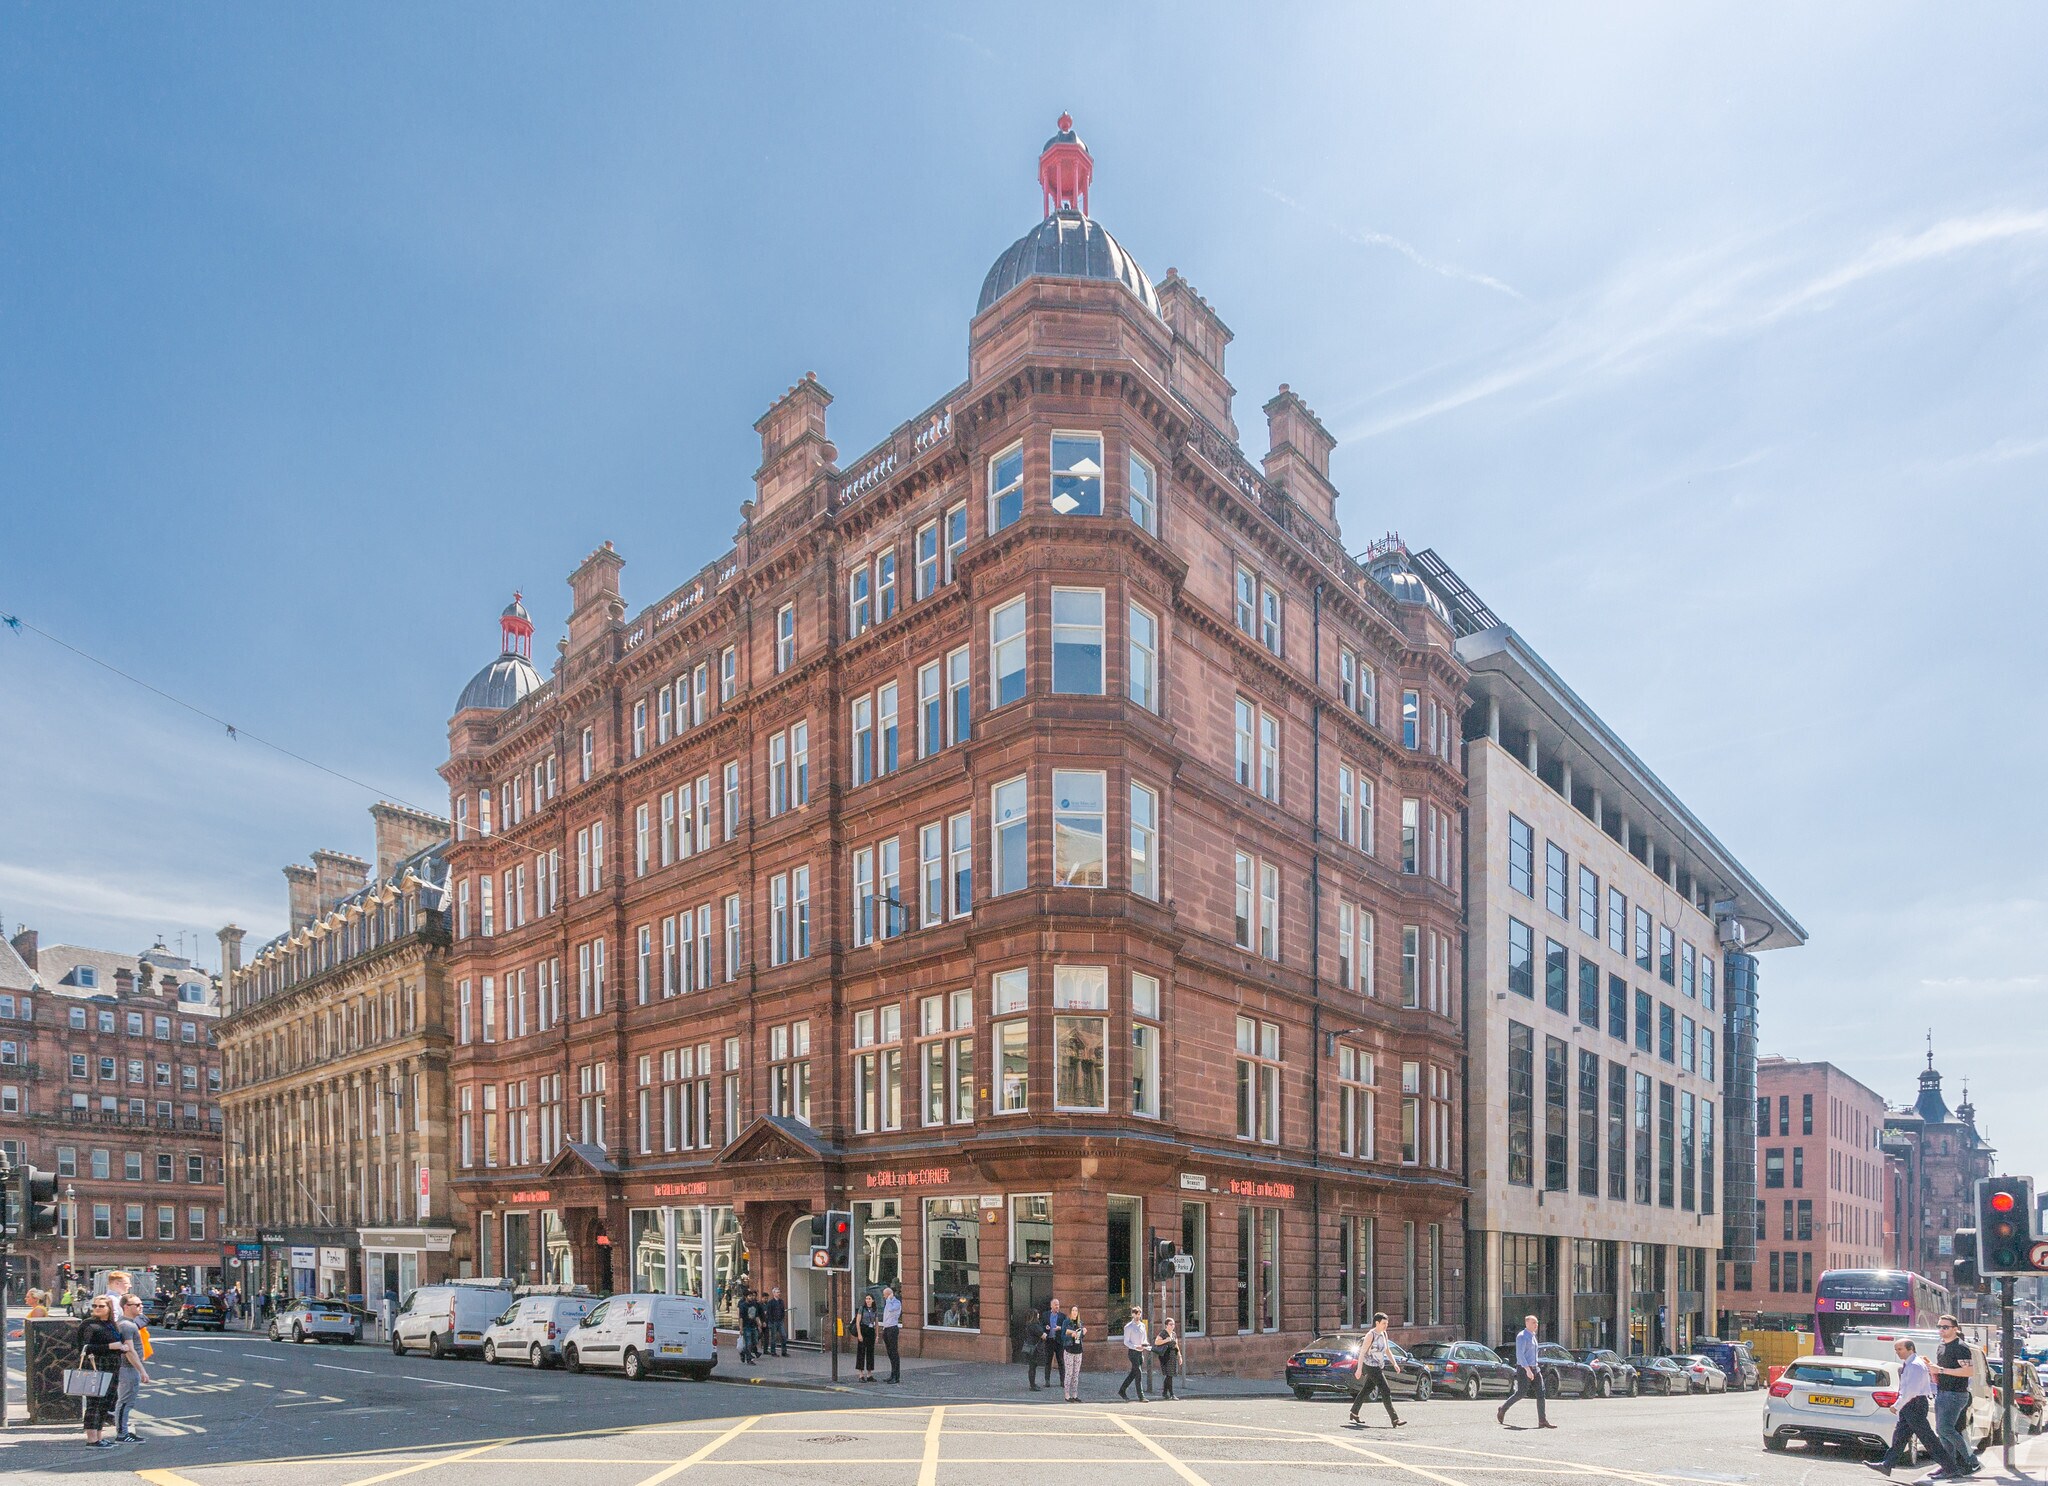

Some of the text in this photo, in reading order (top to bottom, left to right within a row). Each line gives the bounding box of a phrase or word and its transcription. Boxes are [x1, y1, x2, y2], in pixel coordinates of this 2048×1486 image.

[878, 1171, 896, 1186] GRILL
[898, 1174, 907, 1186] on
[908, 1170, 918, 1185] the
[920, 1168, 950, 1184] CORNER
[1240, 1180, 1256, 1196] GRILL
[1273, 1182, 1295, 1199] CORNER
[1835, 1301, 1851, 1310] 500
[692, 1313, 707, 1321] TMA
